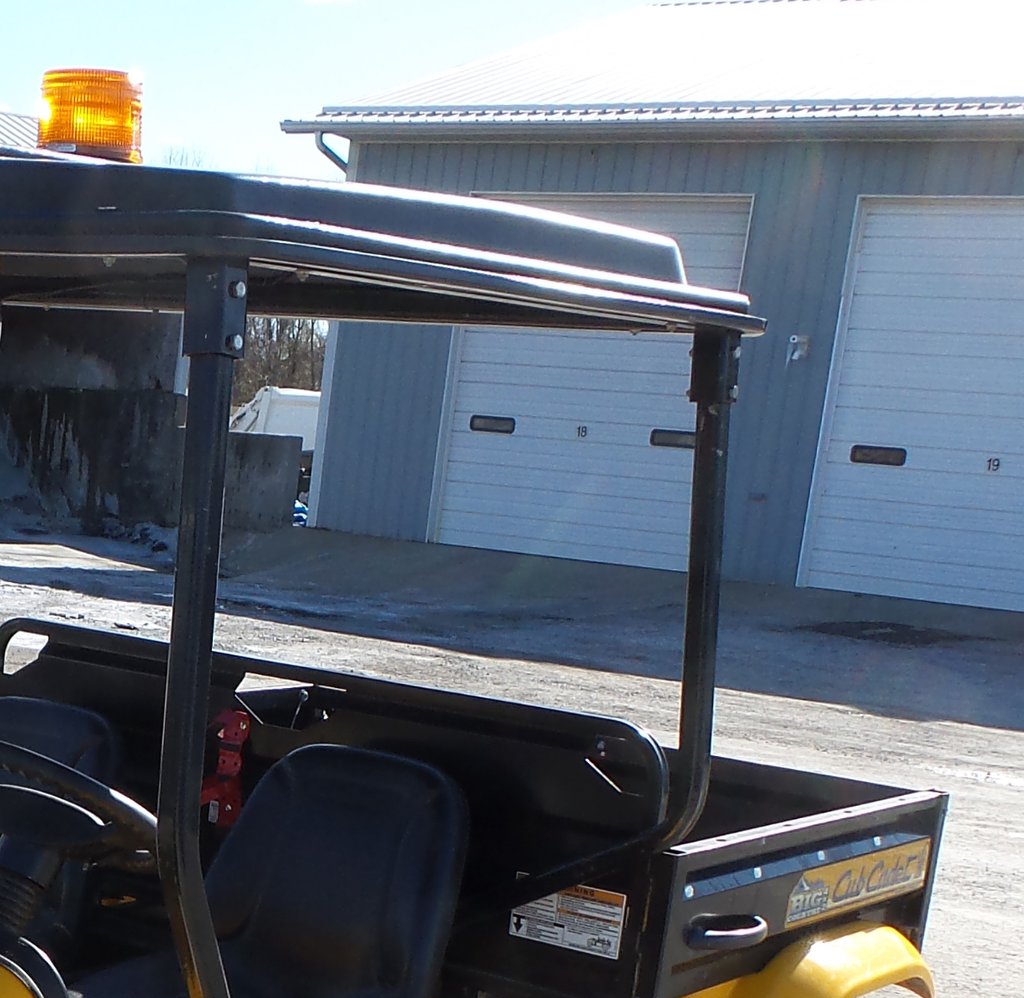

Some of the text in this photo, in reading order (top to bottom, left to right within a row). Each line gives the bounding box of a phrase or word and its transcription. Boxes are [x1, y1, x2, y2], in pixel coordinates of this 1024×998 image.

[577, 425, 588, 438] 18
[986, 457, 1000, 472] 19
[833, 855, 918, 902] Cub Cadet
[790, 890, 823, 914] BIG
